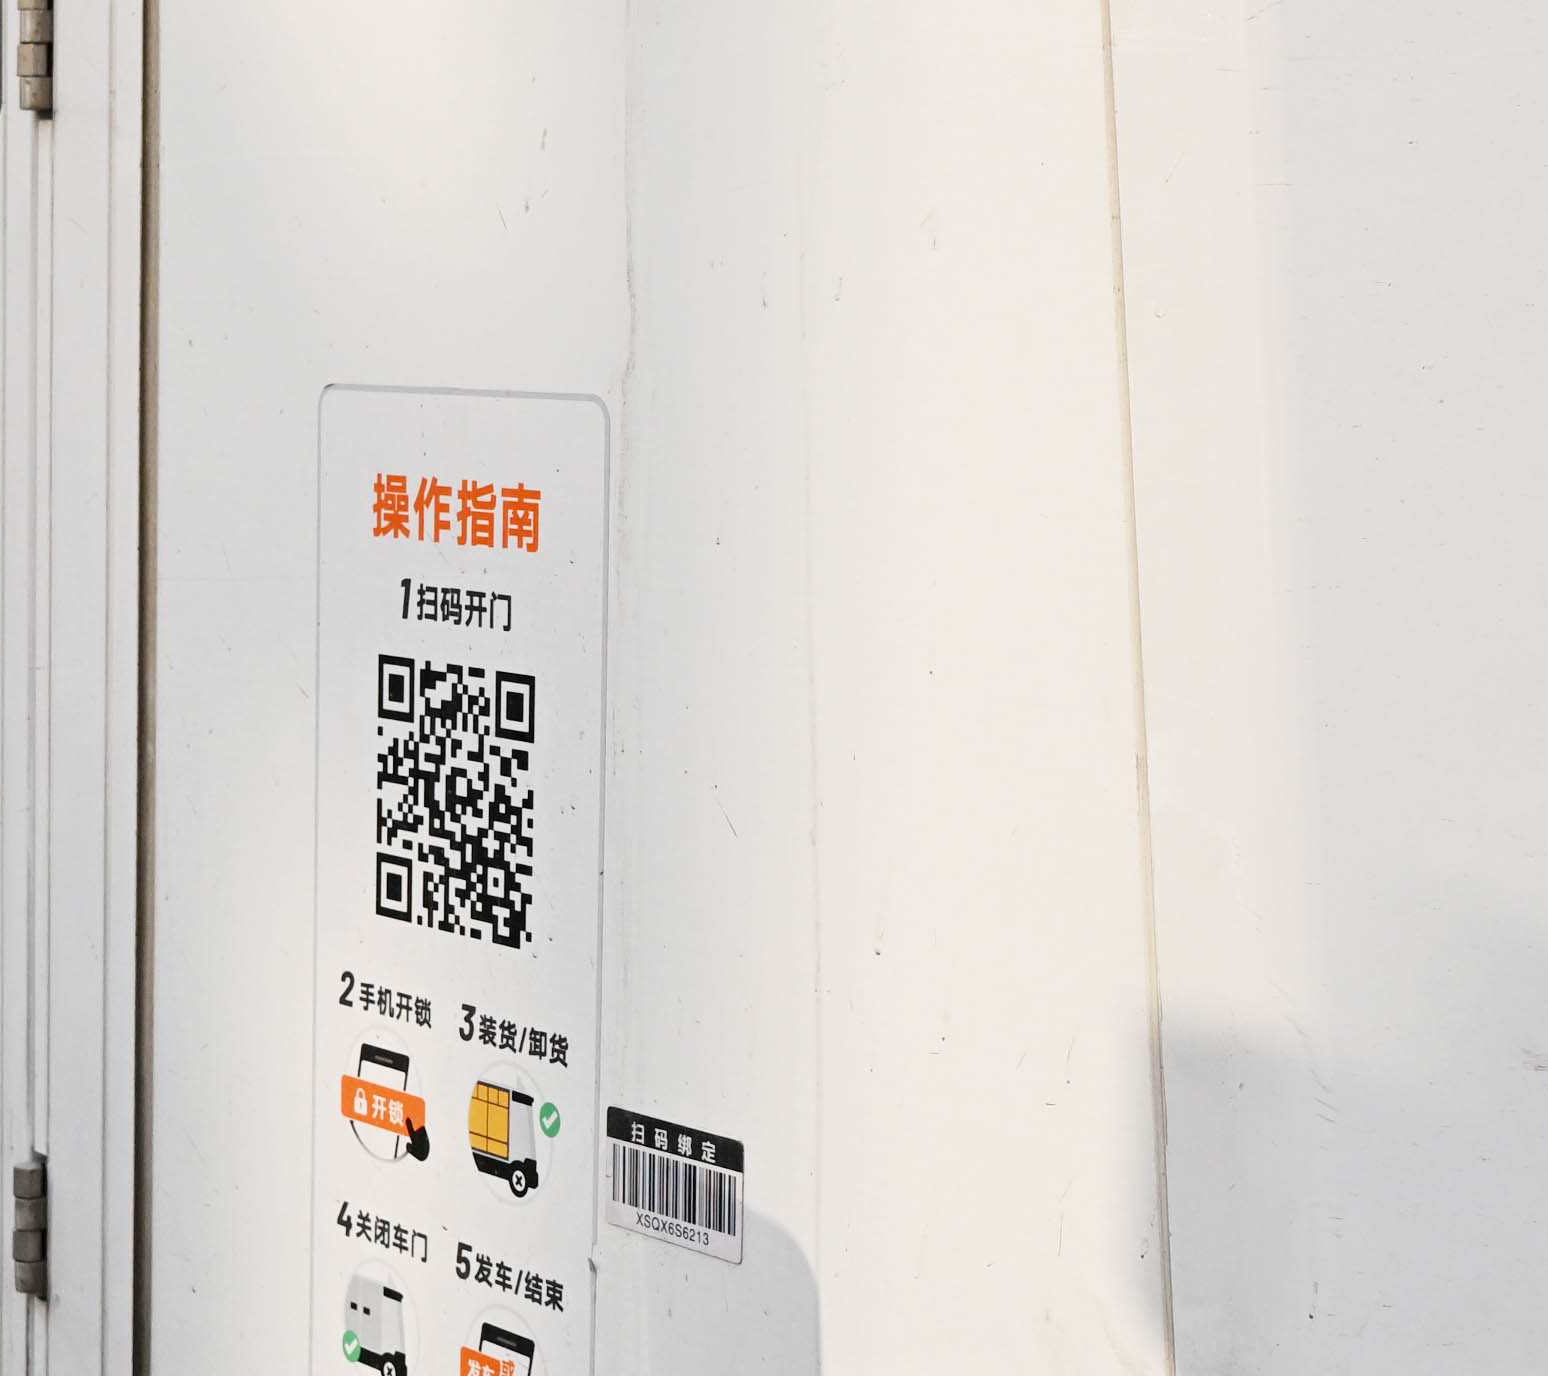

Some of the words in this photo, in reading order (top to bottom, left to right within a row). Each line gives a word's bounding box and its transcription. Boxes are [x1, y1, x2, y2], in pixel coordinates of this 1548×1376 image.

[373, 472, 542, 553] 操作指南
[372, 1094, 404, 1126] 开锁
[632, 1121, 716, 1163] 扫码绑定
[636, 1211, 709, 1246] XSQX6S6213
